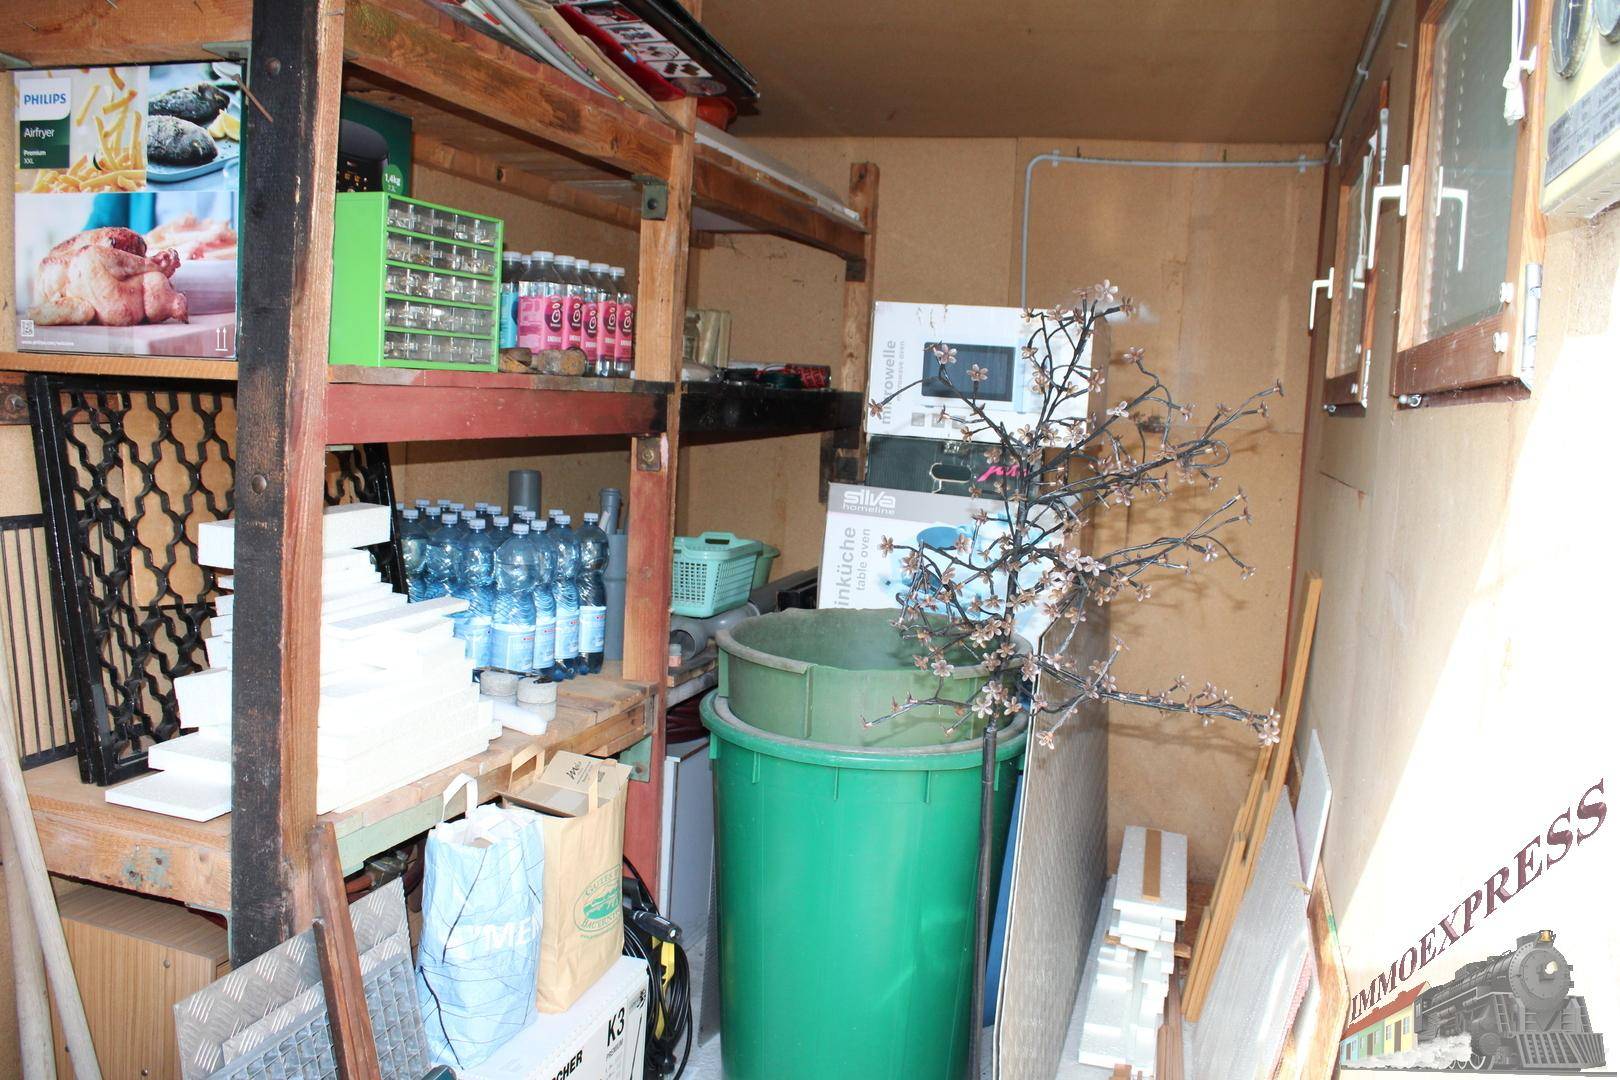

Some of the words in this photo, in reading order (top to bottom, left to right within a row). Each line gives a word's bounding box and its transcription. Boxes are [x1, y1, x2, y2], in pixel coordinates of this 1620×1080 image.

[24, 93, 66, 105] PHILIPS
[24, 127, 55, 139] Airfryer
[23, 157, 34, 165] XXL
[843, 489, 896, 509] silva
[842, 502, 896, 515] homeline
[859, 528, 871, 558] oven
[855, 561, 867, 591] table
